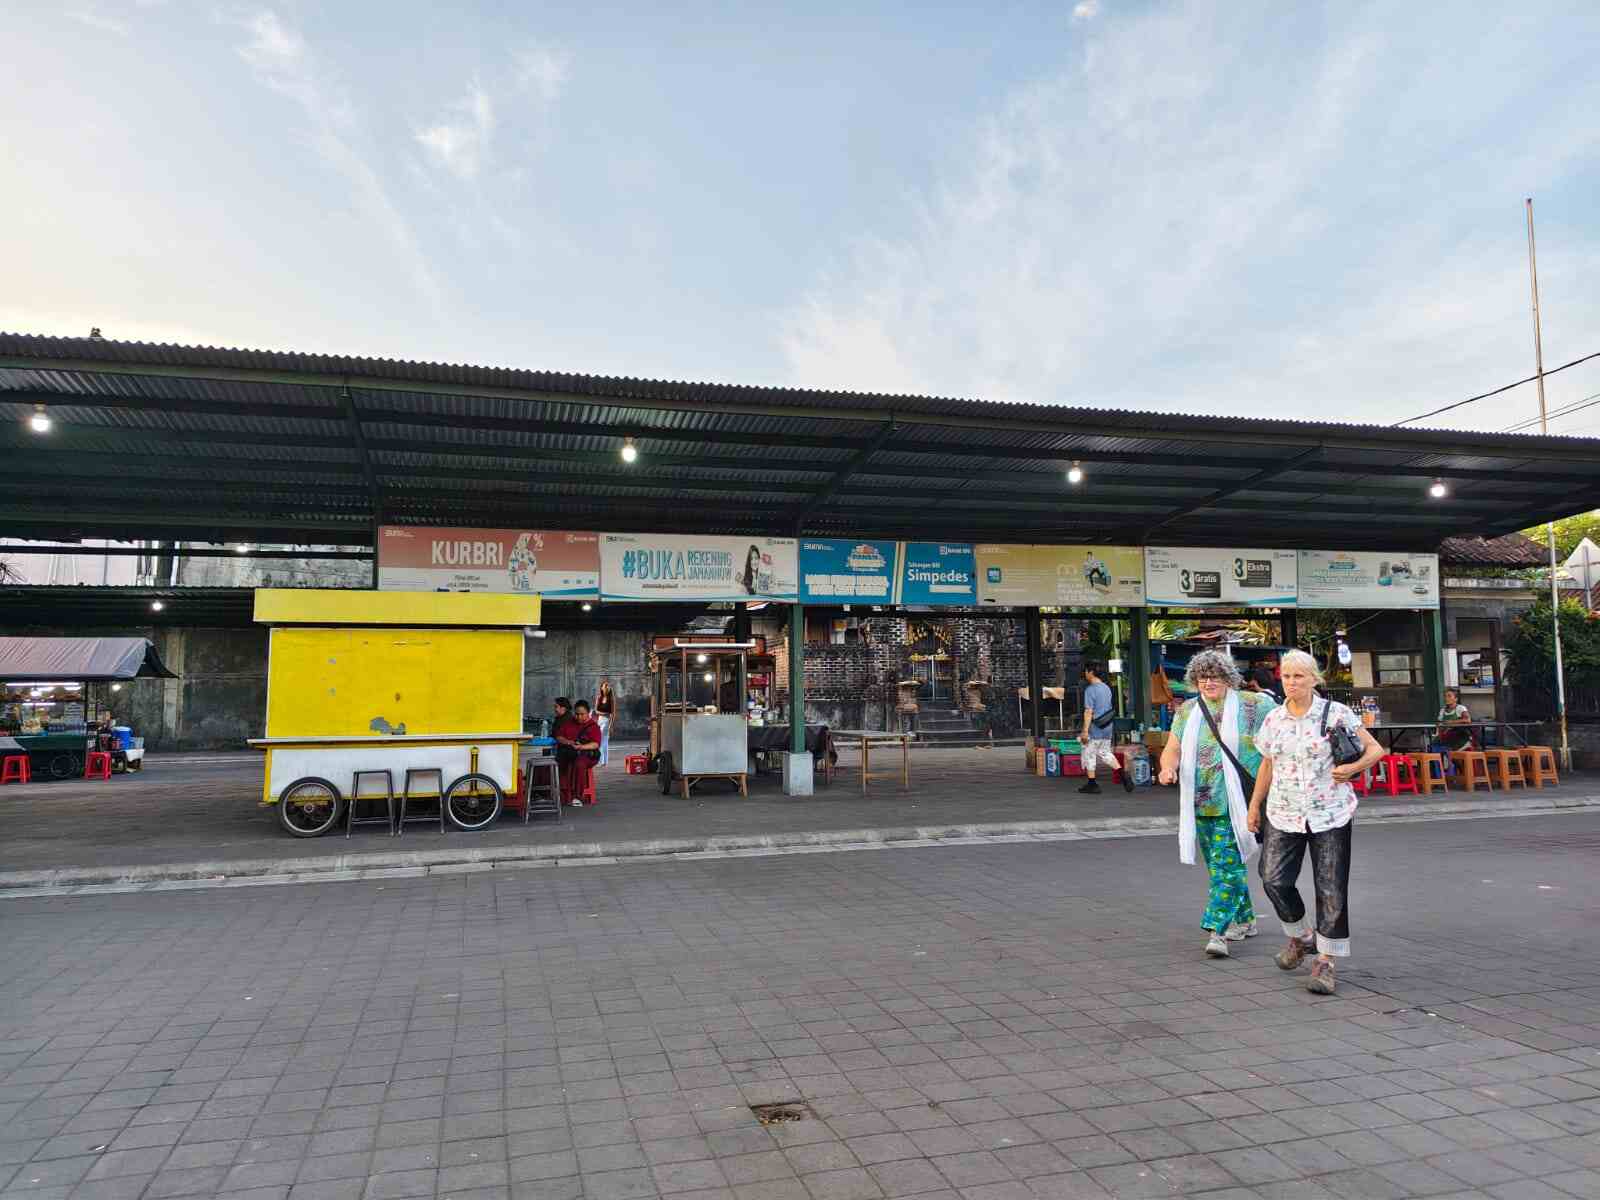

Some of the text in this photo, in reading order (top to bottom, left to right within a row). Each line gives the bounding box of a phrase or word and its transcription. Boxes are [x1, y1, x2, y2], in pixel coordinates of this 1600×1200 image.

[431, 540, 504, 566] KURBRI
[623, 550, 686, 579] #BUKA
[1234, 558, 1245, 578] 3
[907, 568, 969, 584] Simpedes
[1181, 569, 1192, 591] 3
